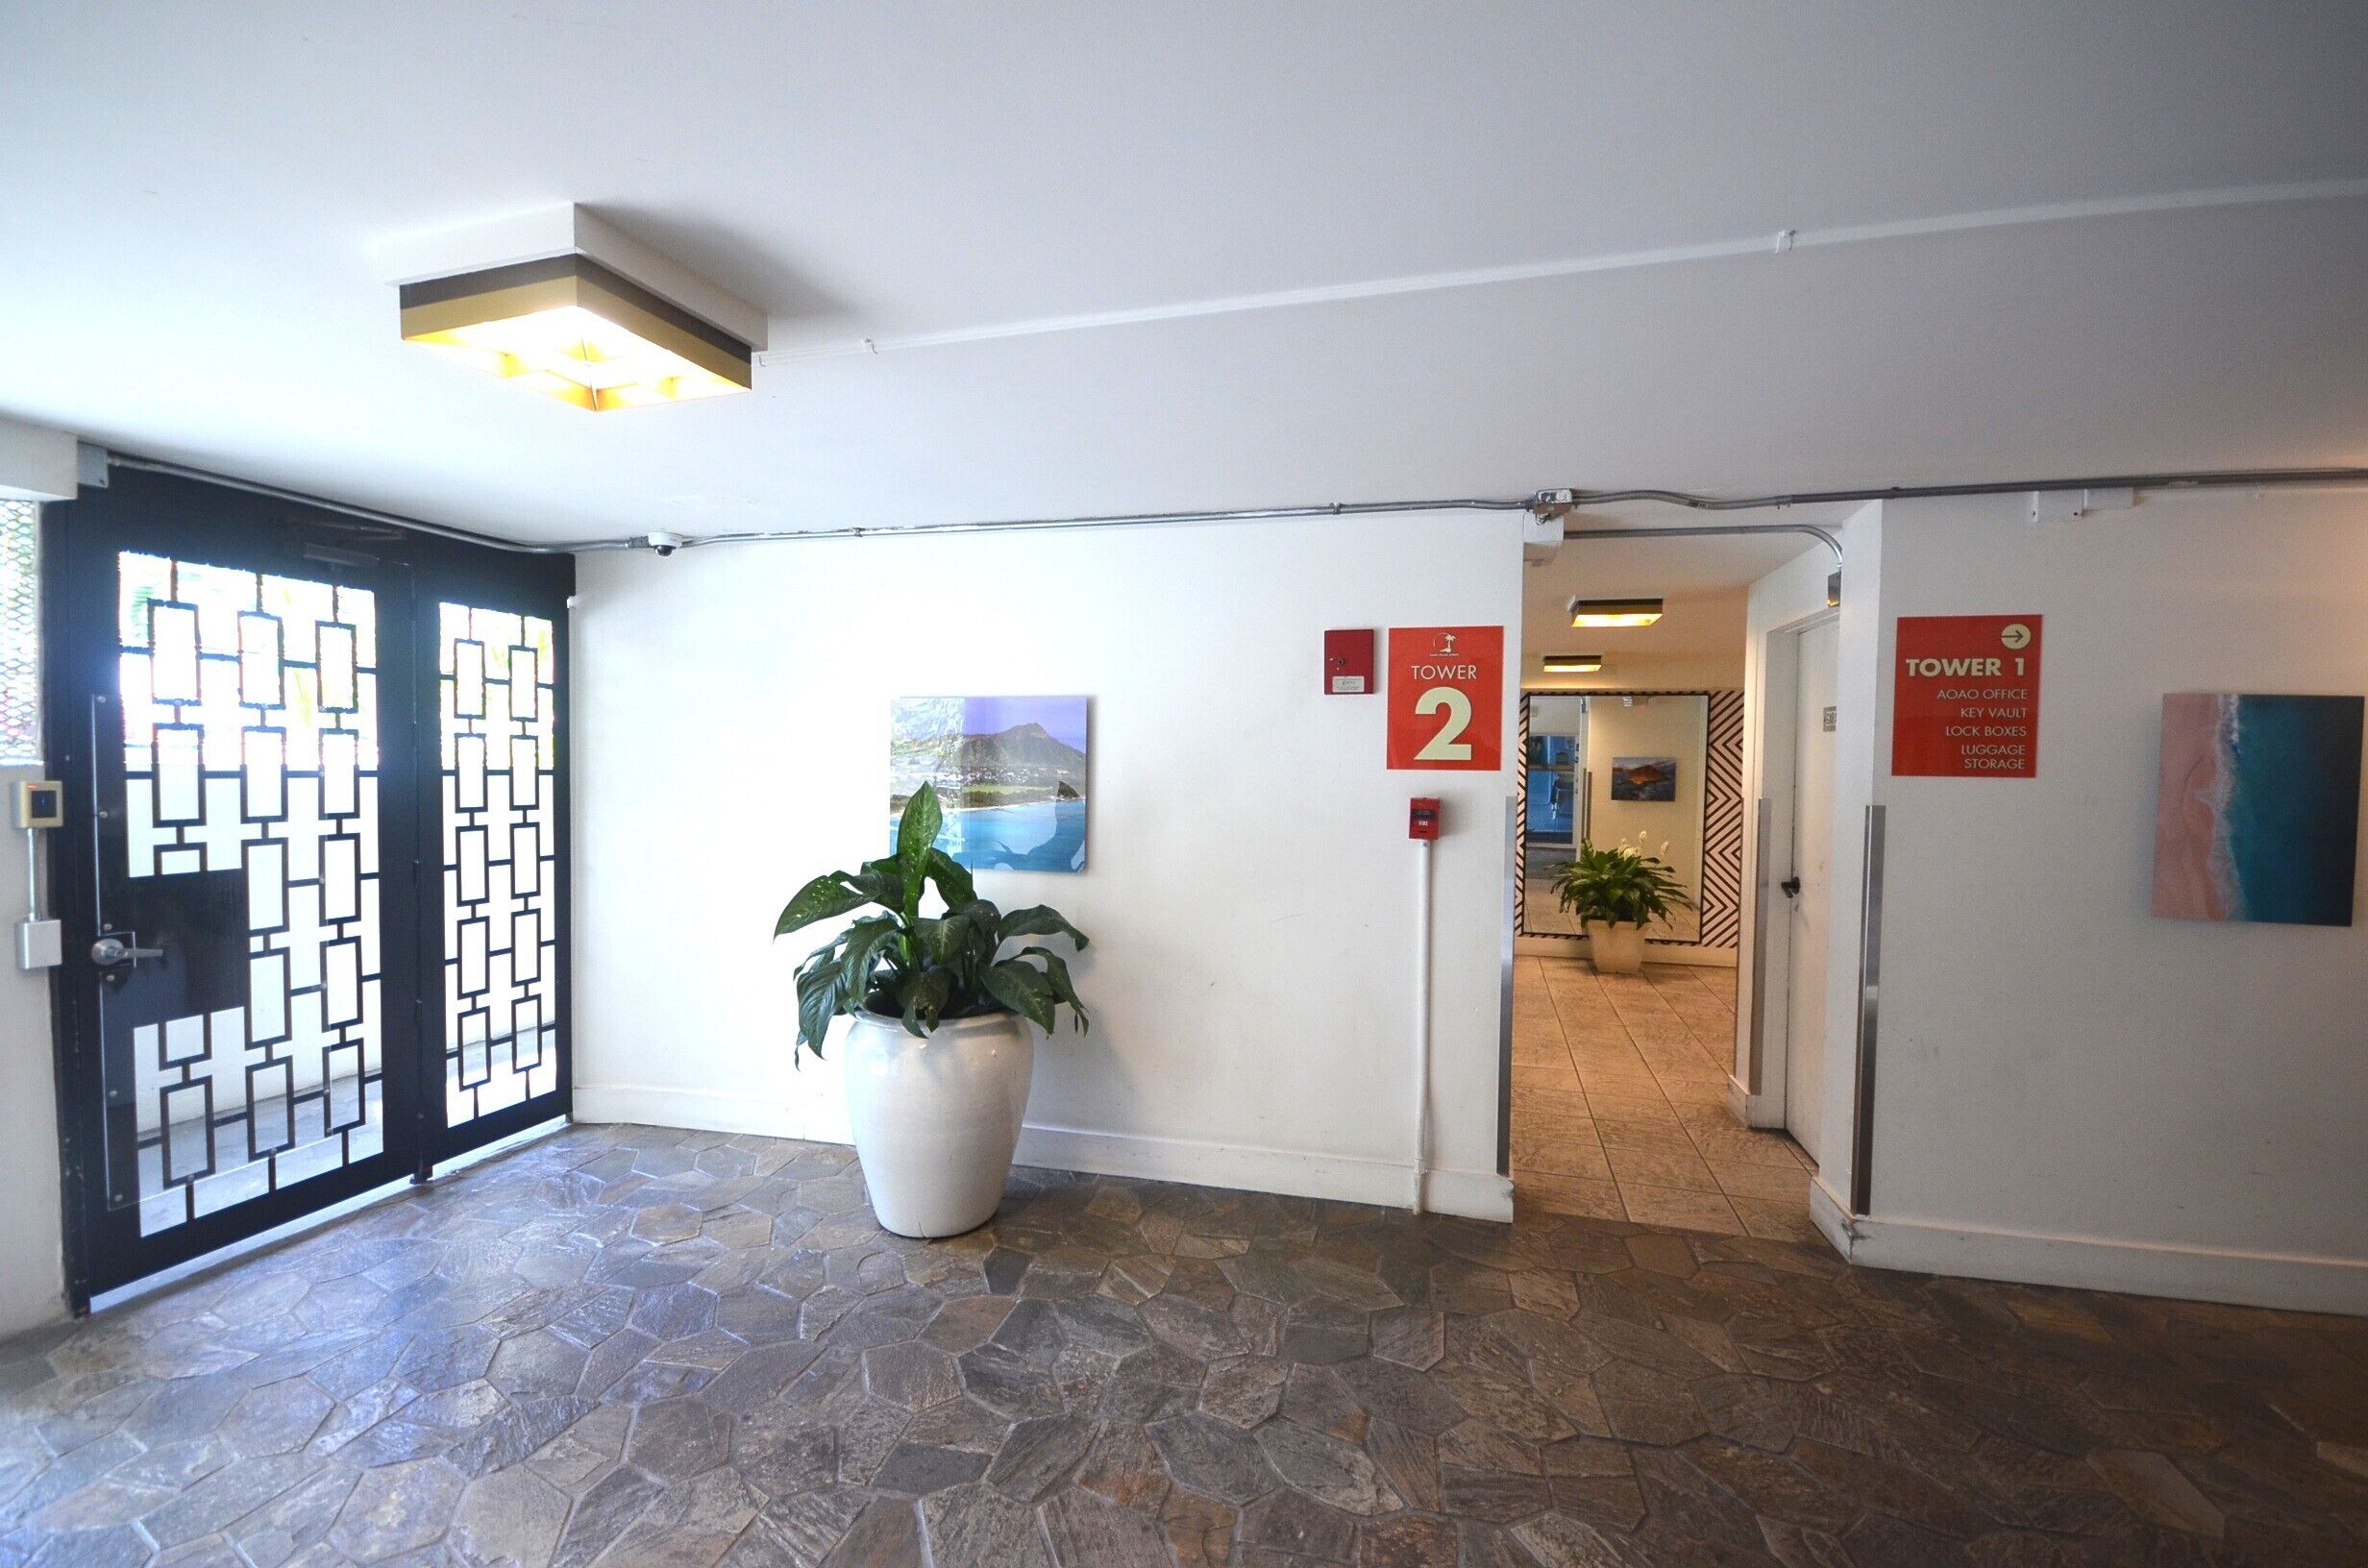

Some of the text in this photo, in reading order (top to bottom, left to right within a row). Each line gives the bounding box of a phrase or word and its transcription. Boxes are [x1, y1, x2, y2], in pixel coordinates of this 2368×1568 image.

[1411, 665, 1477, 680] TOWER
[1906, 657, 2025, 677] TOWER 1
[1936, 689, 2028, 699] AOAO OFFICE
[1961, 707, 2028, 719] KEY VAULT
[1414, 686, 1472, 761] 2
[1946, 725, 2027, 737] LOCK BOXES
[1961, 745, 2026, 755] LUGGAGE
[1963, 758, 2026, 770] STORAGE
